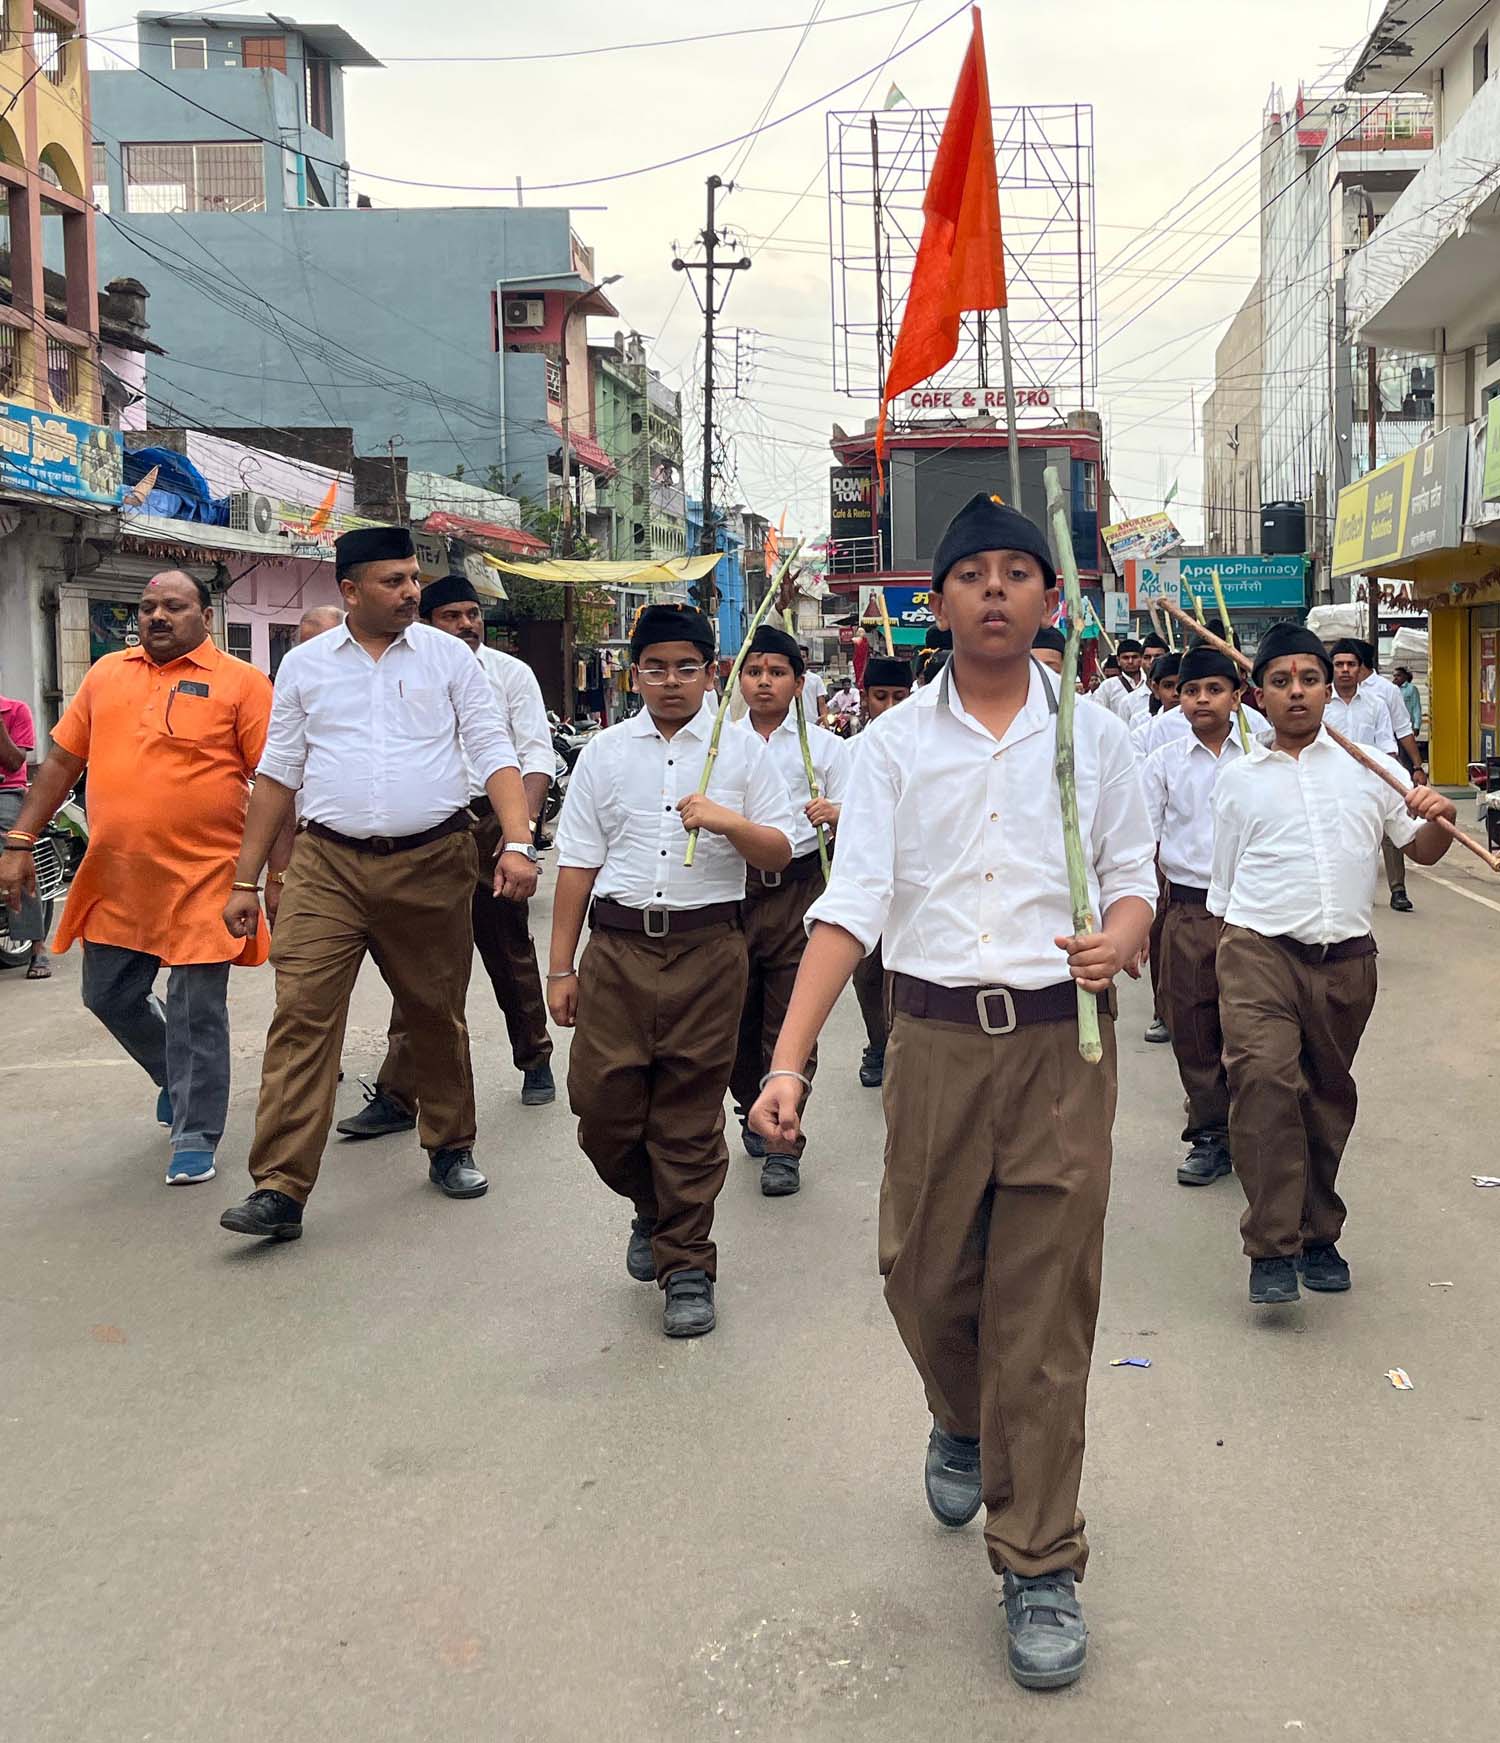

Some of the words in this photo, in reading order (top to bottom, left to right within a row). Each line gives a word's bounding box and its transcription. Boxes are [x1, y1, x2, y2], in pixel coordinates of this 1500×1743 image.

[911, 392, 952, 408] CAFE
[961, 391, 976, 407] &
[984, 390, 1050, 407] RETRO
[1117, 516, 1153, 530] ANURAG
